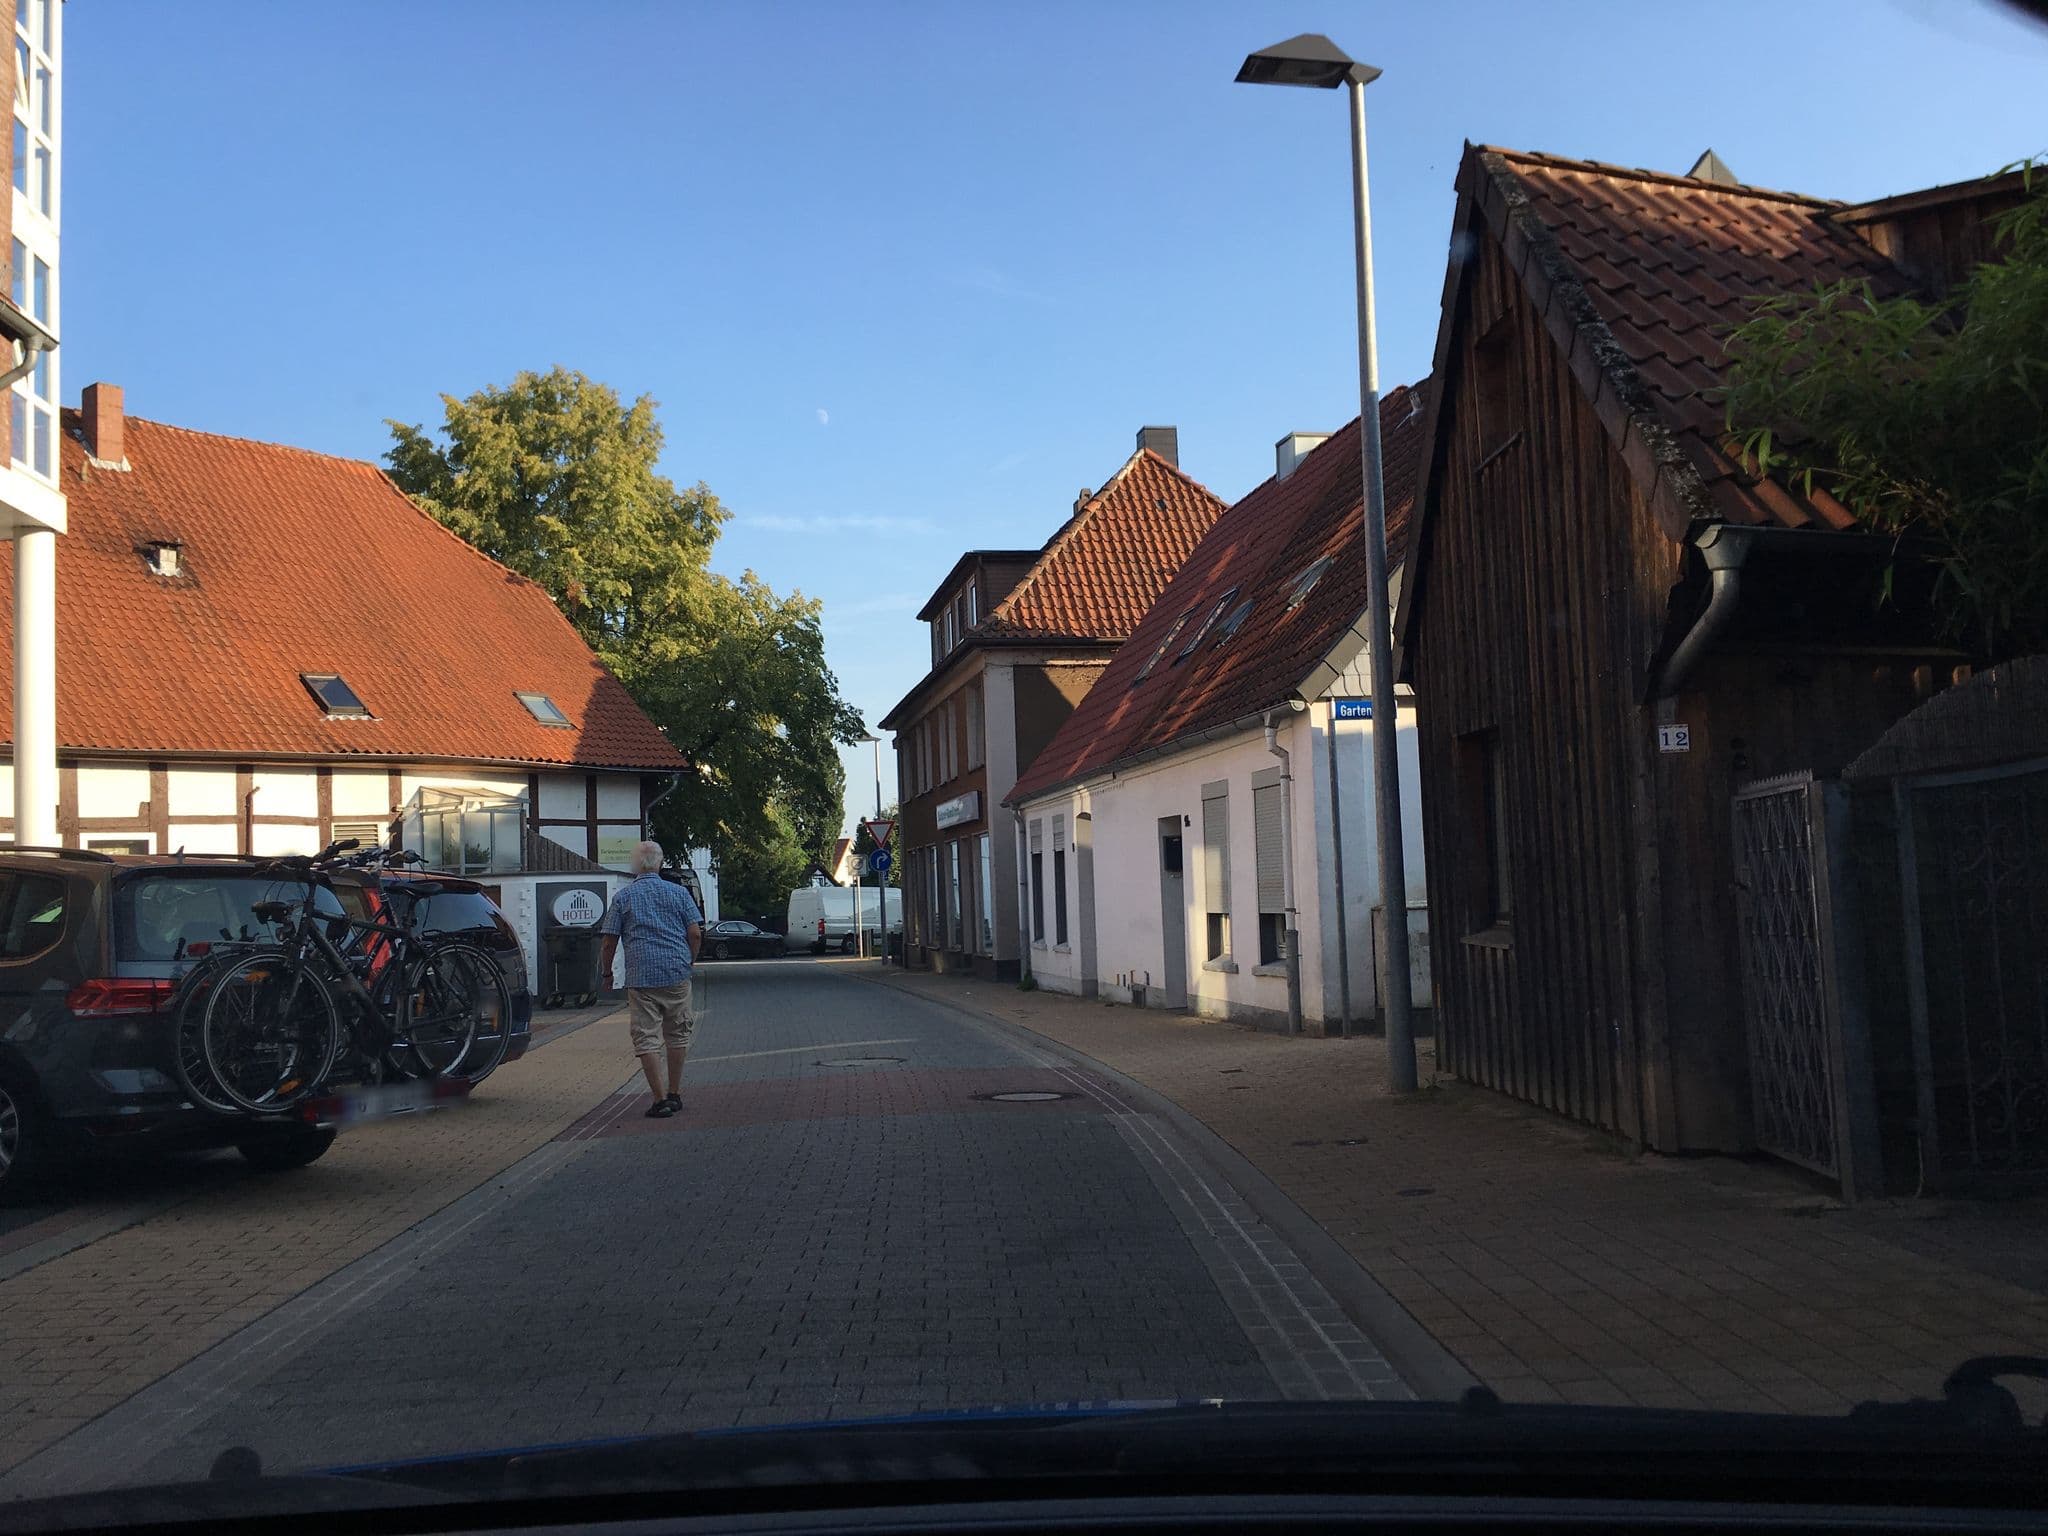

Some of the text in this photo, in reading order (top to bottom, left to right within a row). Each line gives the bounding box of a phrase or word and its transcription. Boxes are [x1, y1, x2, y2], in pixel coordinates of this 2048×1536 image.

[1340, 704, 1372, 717] Garten
[1661, 732, 1688, 746] 12
[562, 910, 597, 921] HOTEL
